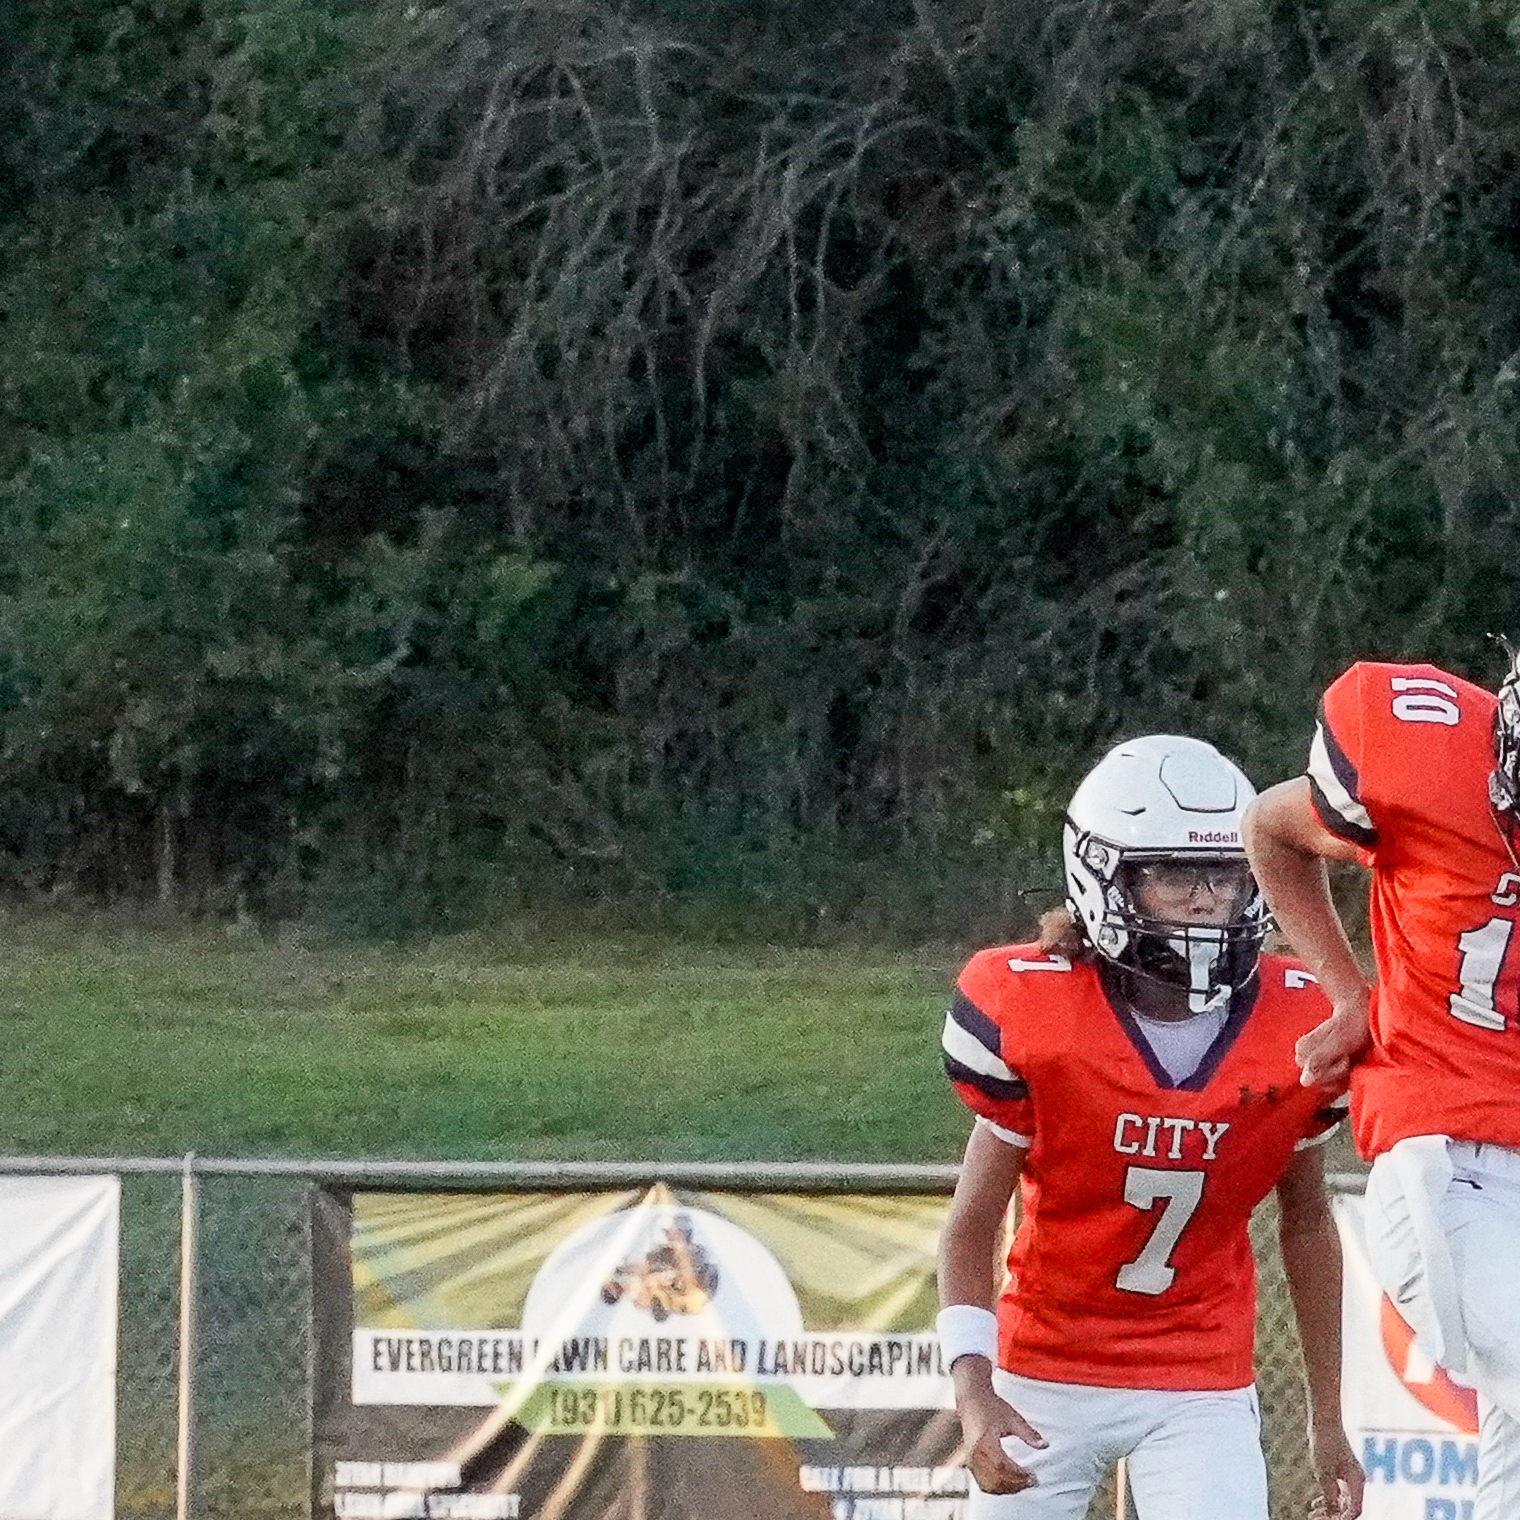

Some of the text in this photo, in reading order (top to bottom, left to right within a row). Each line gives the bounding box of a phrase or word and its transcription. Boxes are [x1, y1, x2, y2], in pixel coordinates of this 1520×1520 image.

[1187, 831, 1240, 845] Riddell
[1113, 1112, 1231, 1161] CITY
[1115, 1165, 1206, 1296] 7
[373, 1337, 523, 1373] EVERGREEN
[619, 1338, 688, 1374] CARE
[698, 1337, 747, 1373] AND
[629, 1388, 767, 1428] 625-2539
[1364, 1437, 1480, 1487] HOM
